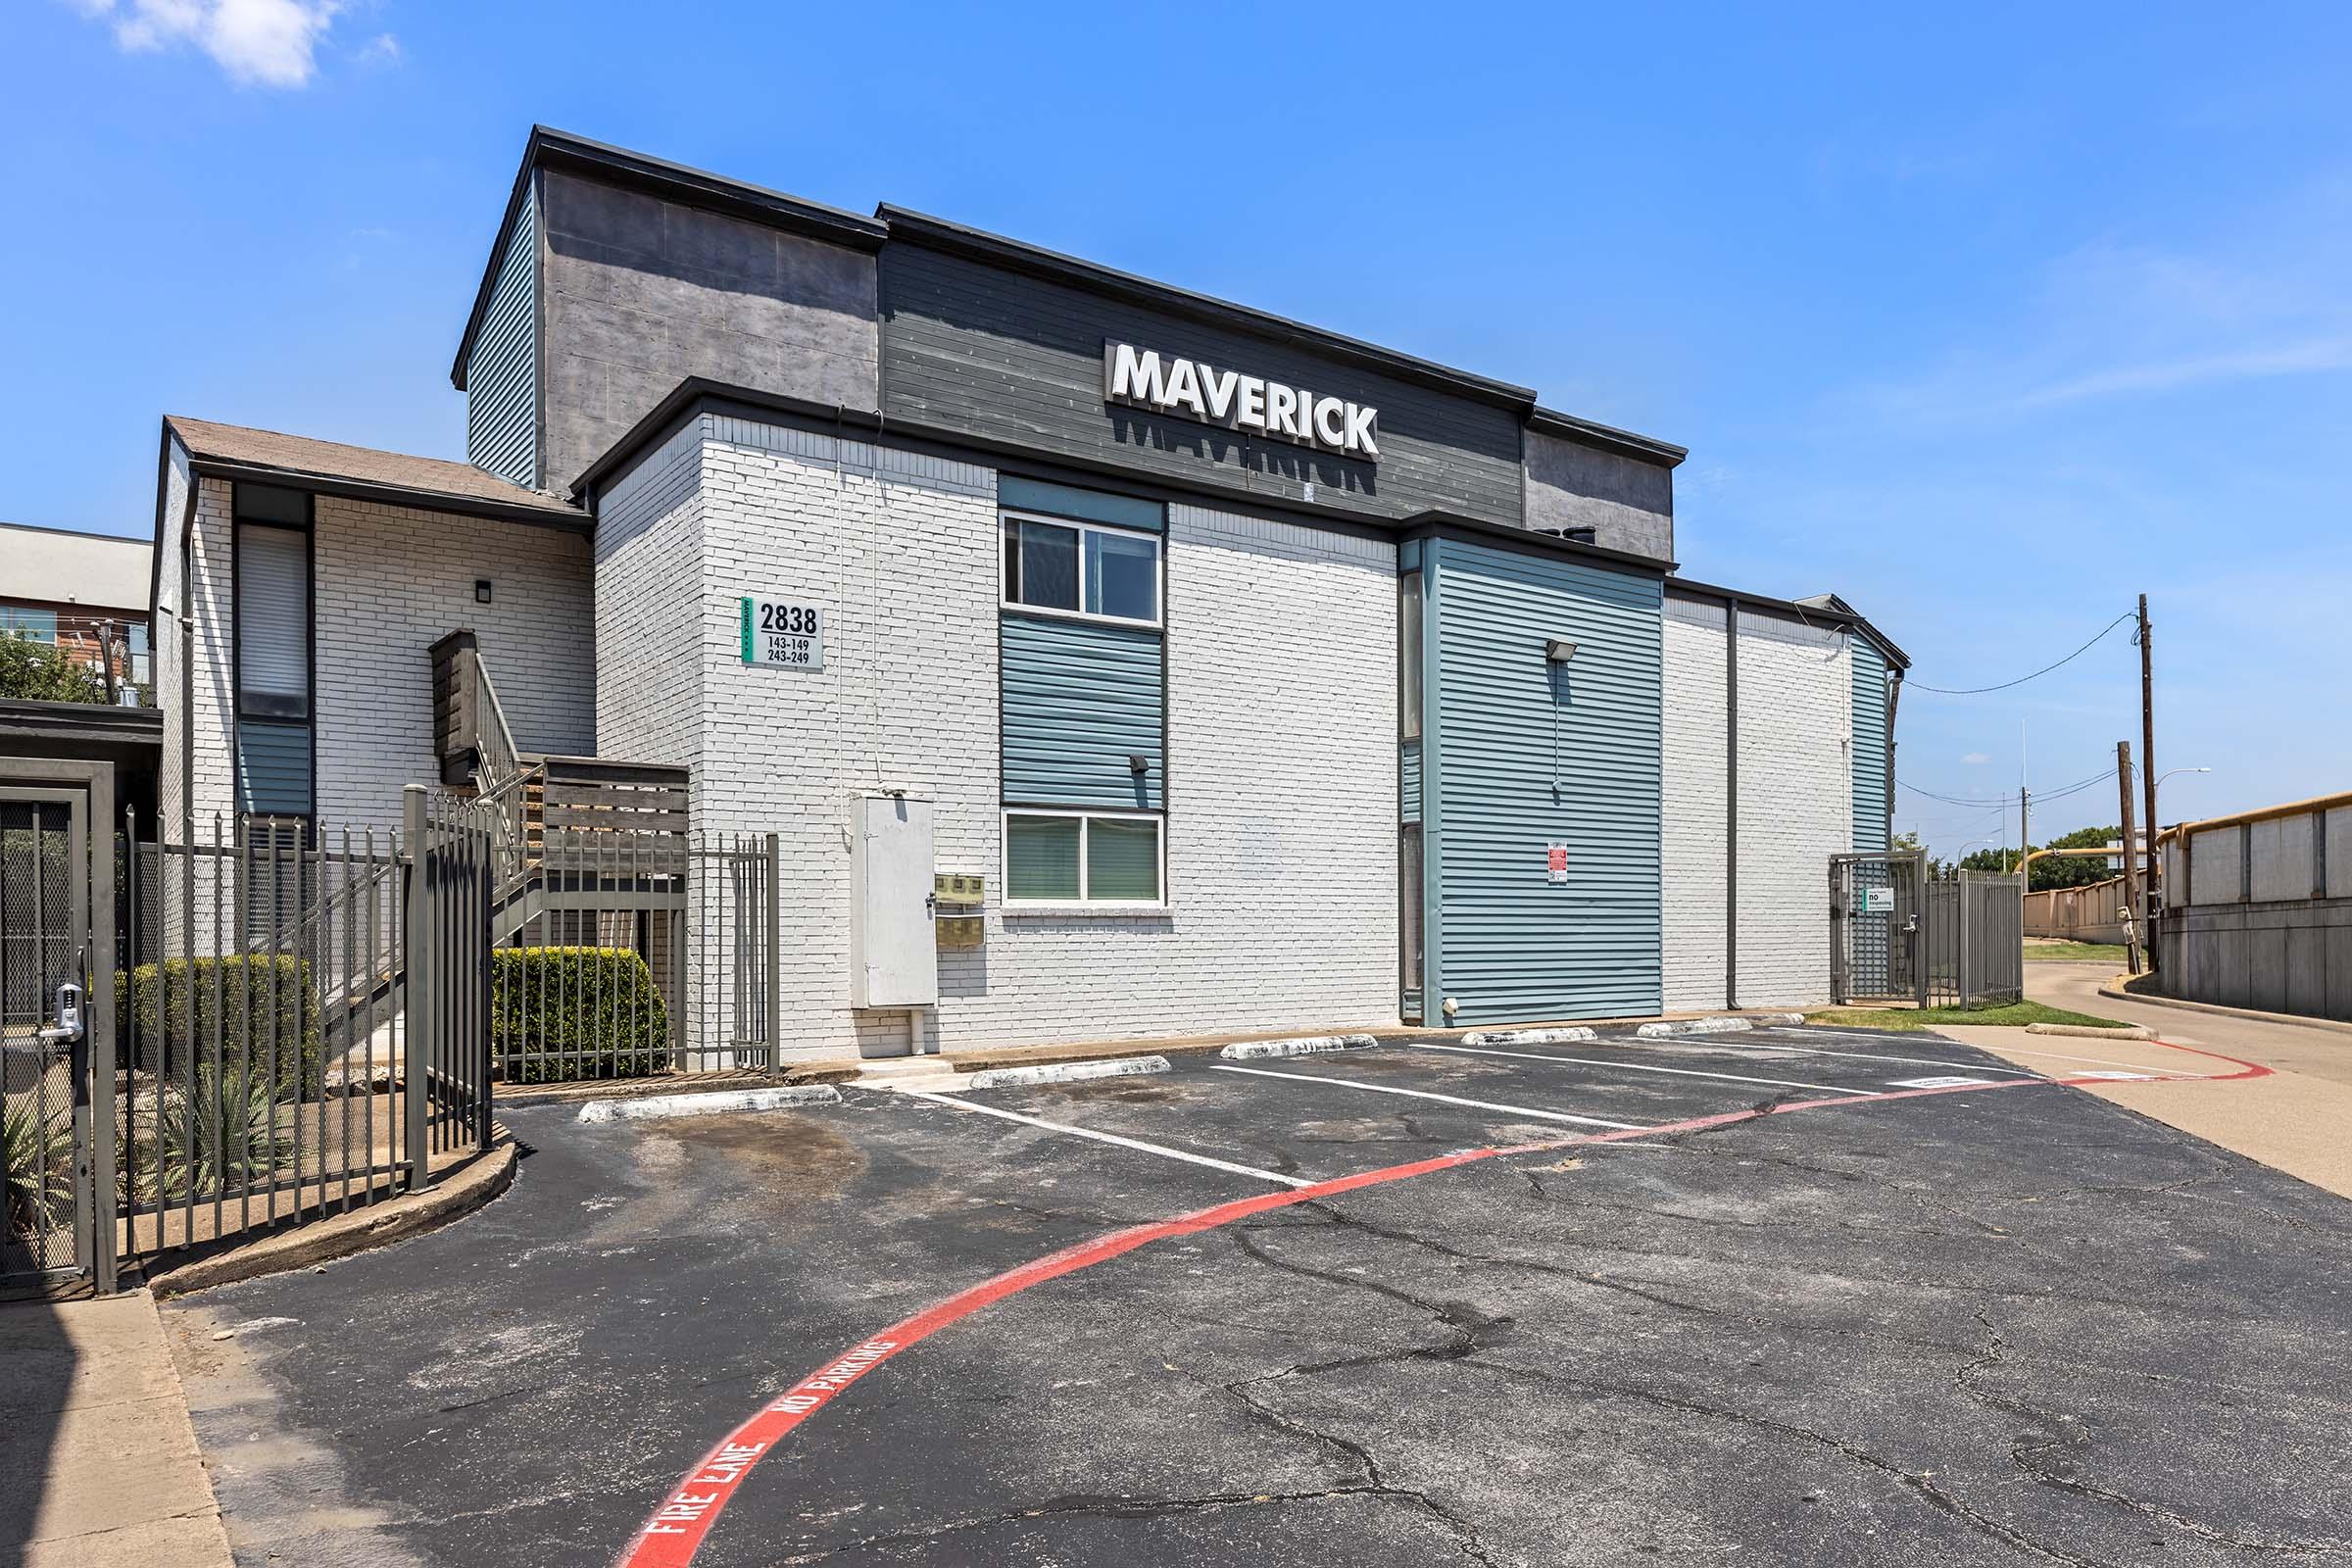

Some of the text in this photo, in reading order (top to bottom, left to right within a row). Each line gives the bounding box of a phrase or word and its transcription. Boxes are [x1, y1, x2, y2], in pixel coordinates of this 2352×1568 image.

[1111, 343, 1380, 455] MAVERICK
[760, 603, 817, 634] 2838
[767, 649, 809, 663] 243-249
[768, 636, 809, 651] 143-149
[644, 1340, 899, 1534] FIRE LANE NO PARKING
